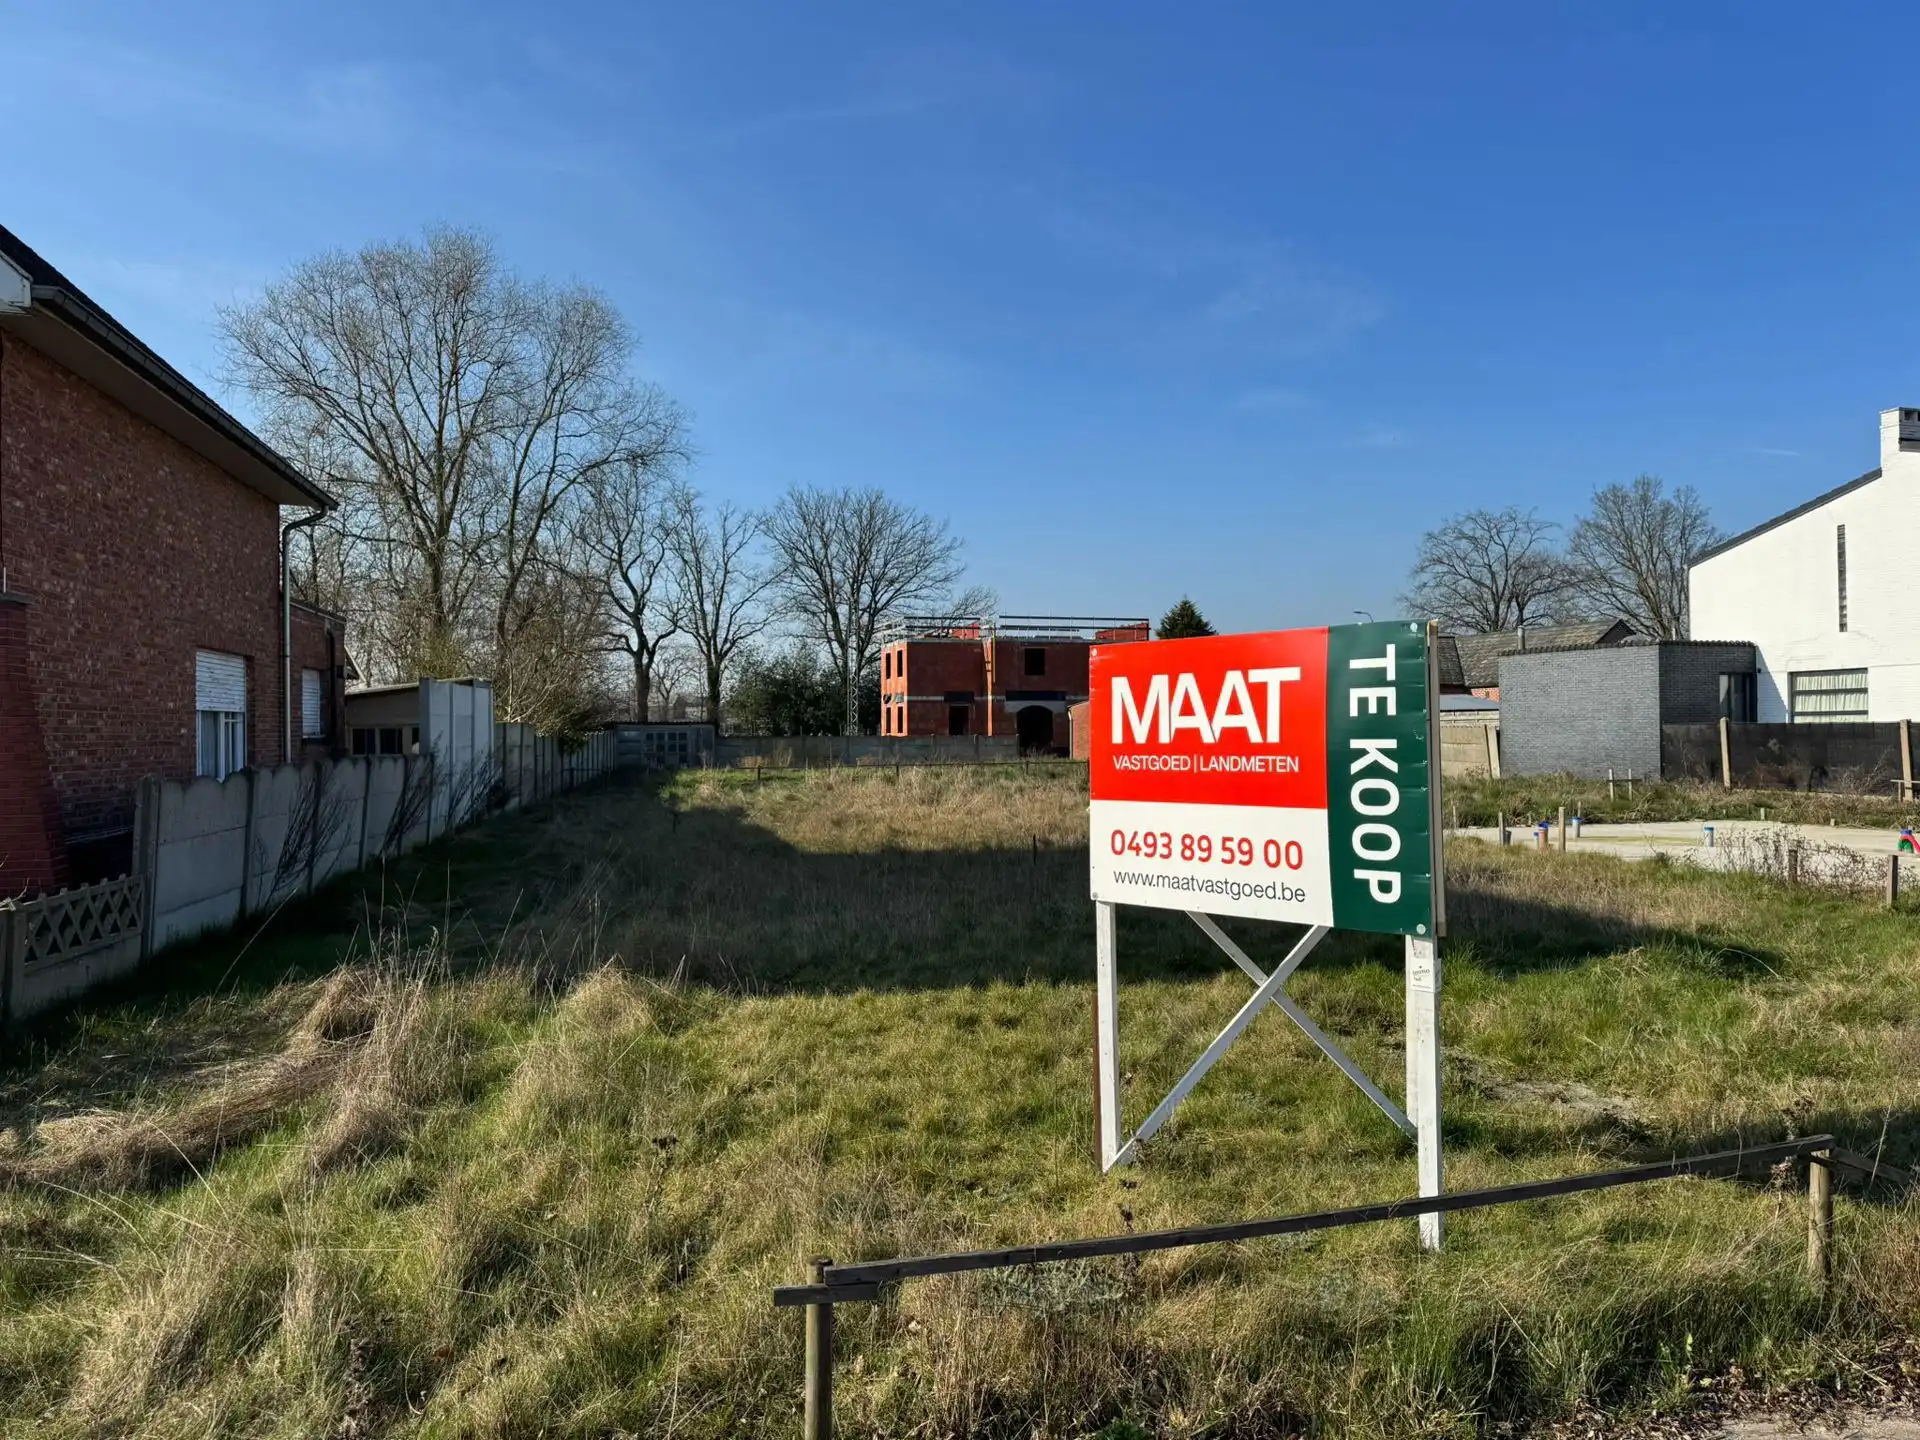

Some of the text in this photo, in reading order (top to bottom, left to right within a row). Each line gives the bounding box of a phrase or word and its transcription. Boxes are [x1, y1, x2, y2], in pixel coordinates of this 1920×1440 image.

[1111, 666, 1301, 744] MAAT
[1112, 755, 1300, 773] VASTGOED LANDMETEN
[1349, 643, 1402, 904] TE KOOP
[1111, 829, 1303, 870] 0493 89 59 00
[1113, 869, 1306, 903] www.maatvastgoed.be
